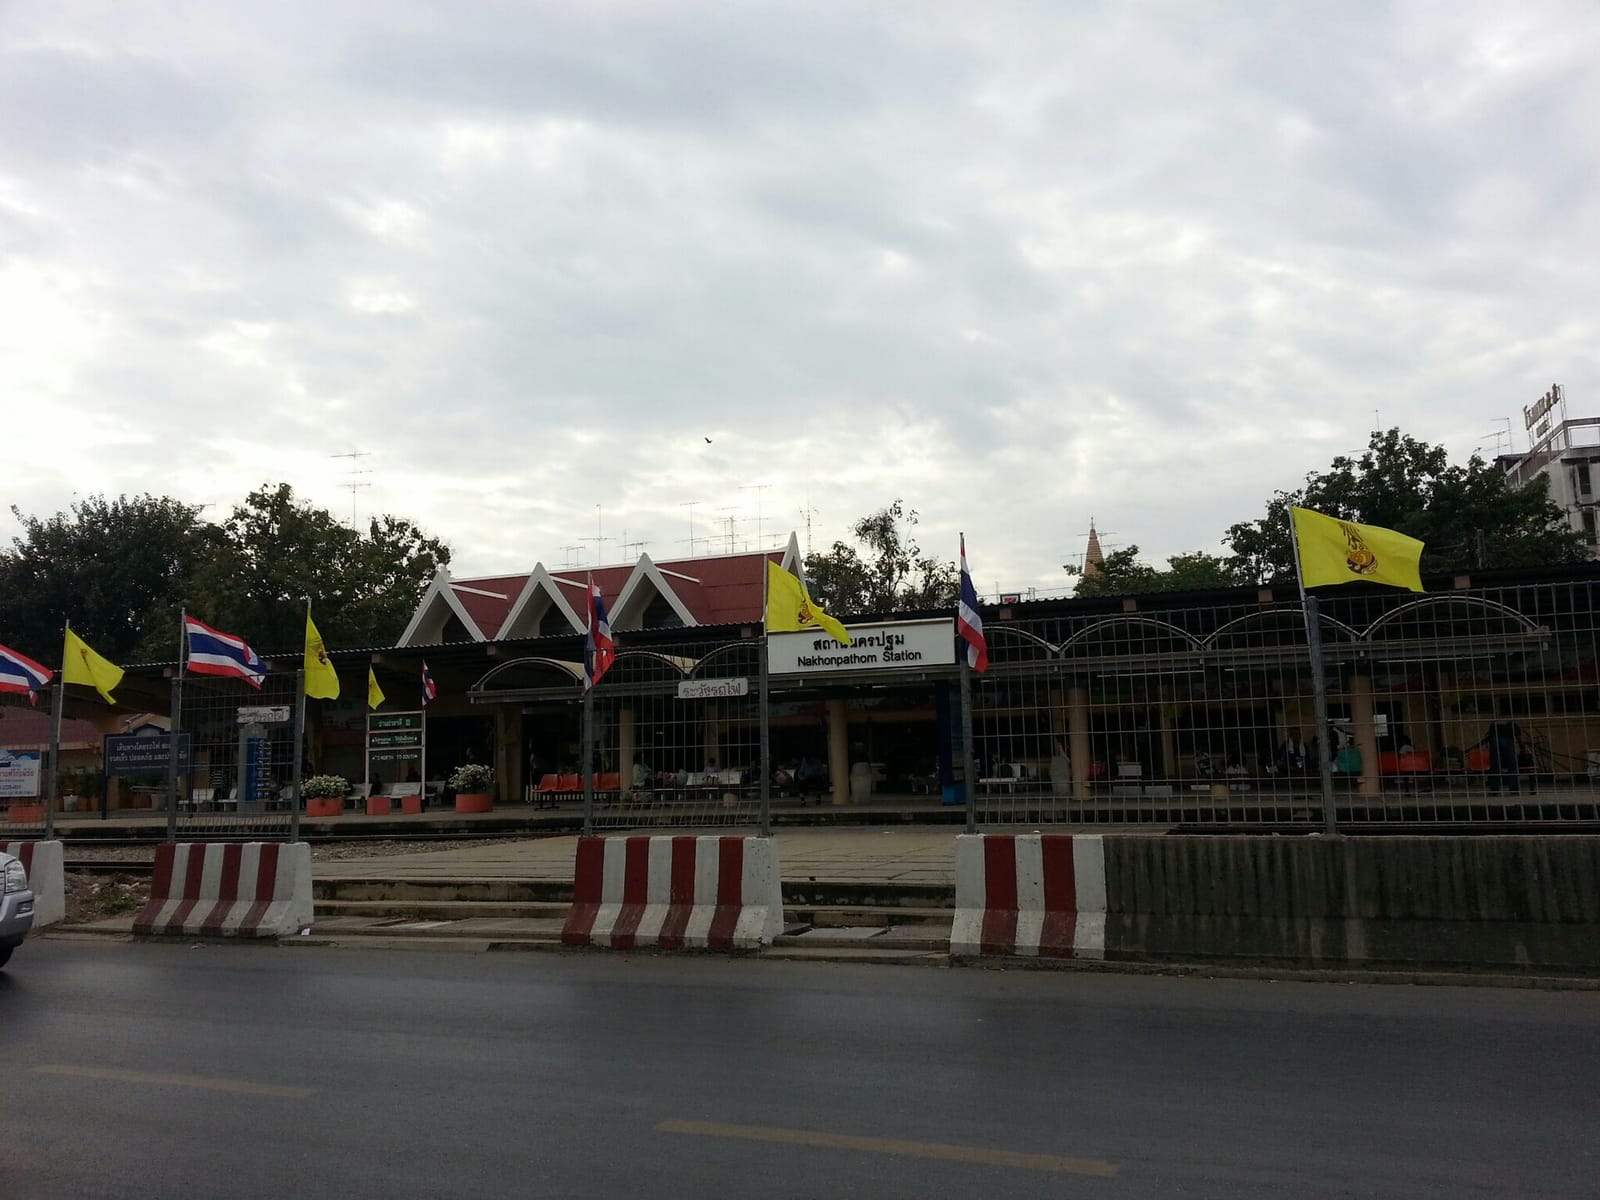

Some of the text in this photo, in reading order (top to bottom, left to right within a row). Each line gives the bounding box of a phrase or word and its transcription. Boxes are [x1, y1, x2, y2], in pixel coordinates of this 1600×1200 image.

[798, 650, 922, 667] Nakhonpathom Station
[682, 681, 741, 697] ระวังรถไฟ
